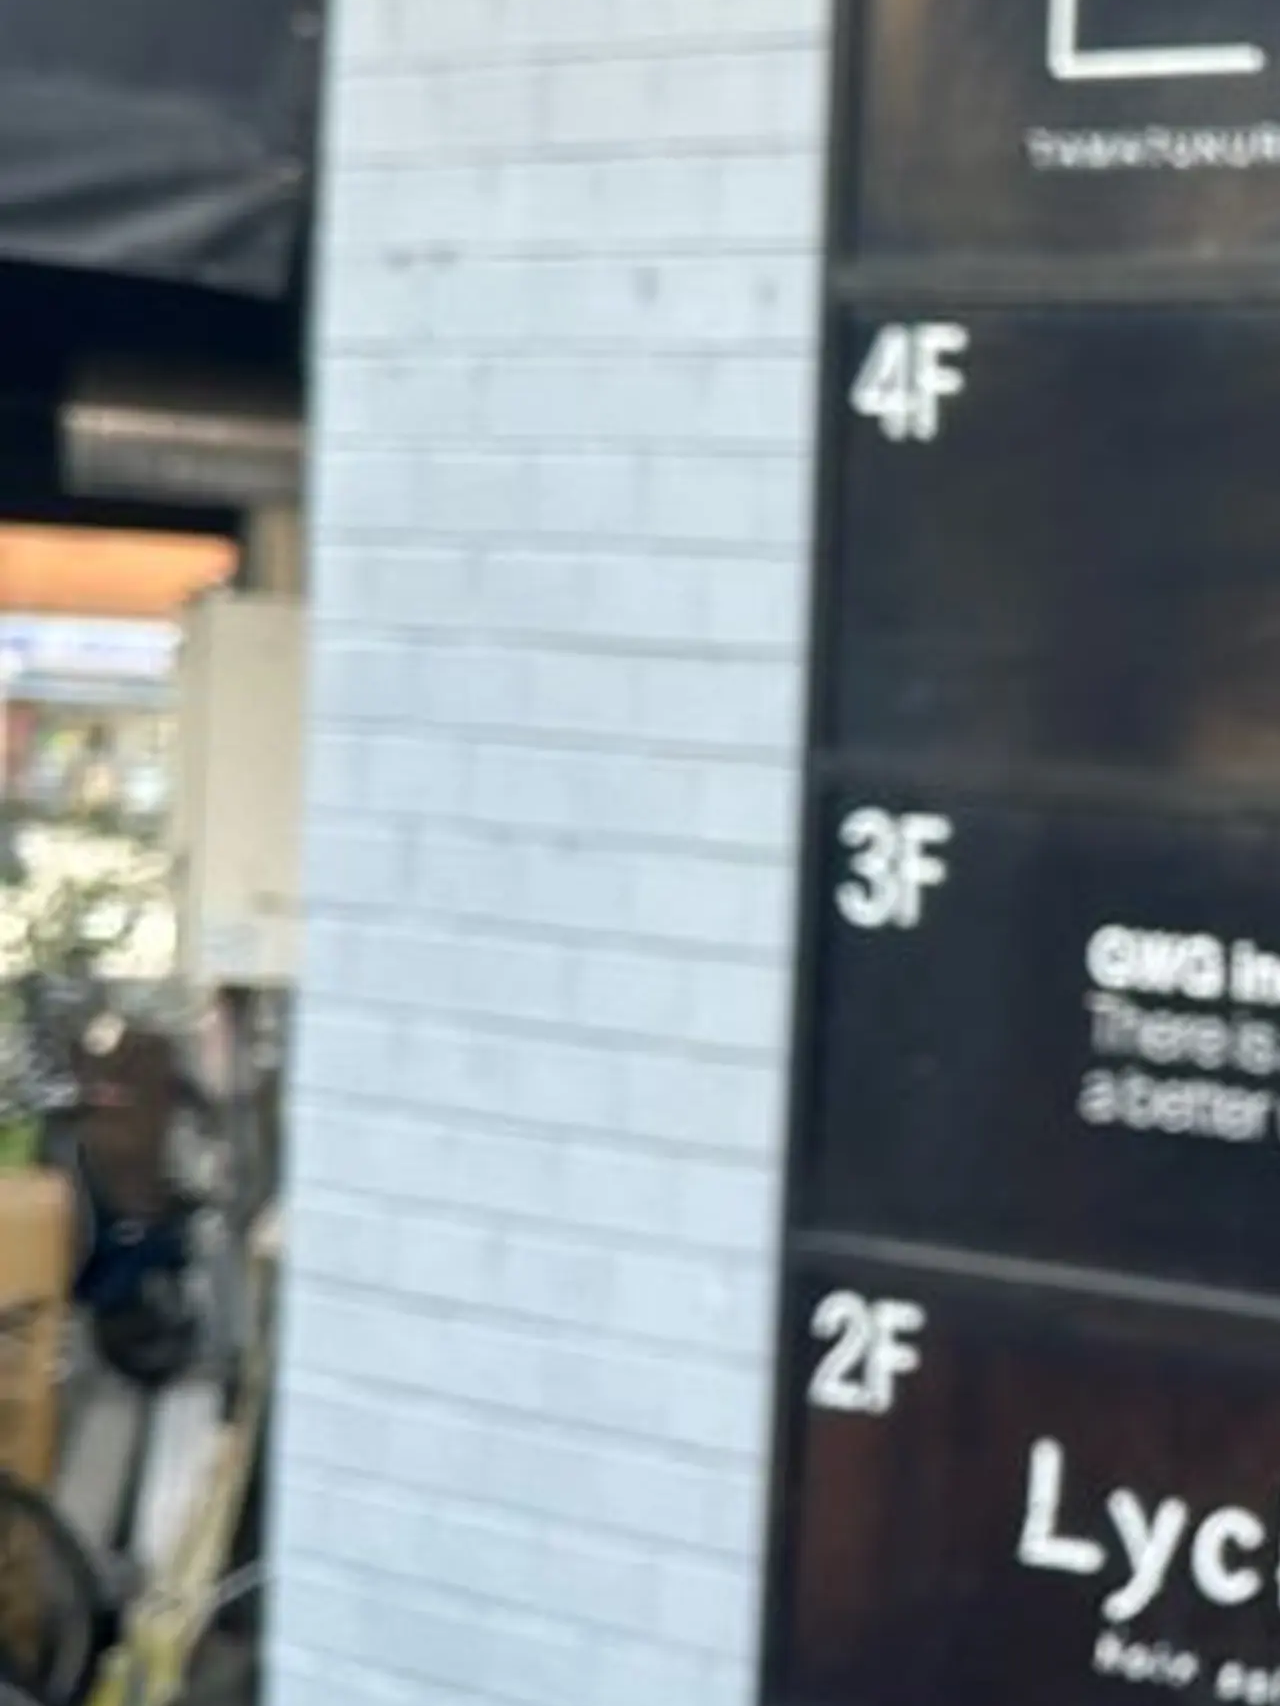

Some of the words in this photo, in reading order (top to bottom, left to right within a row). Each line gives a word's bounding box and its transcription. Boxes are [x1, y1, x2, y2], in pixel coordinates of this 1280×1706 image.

[850, 320, 970, 442] 4F
[835, 805, 953, 930] 3F
[1084, 992, 1228, 1070] There
[1232, 1012, 1278, 1075] is
[1080, 1070, 1117, 1134] a
[1120, 1070, 1270, 1141] better
[807, 1288, 926, 1415] 2F
